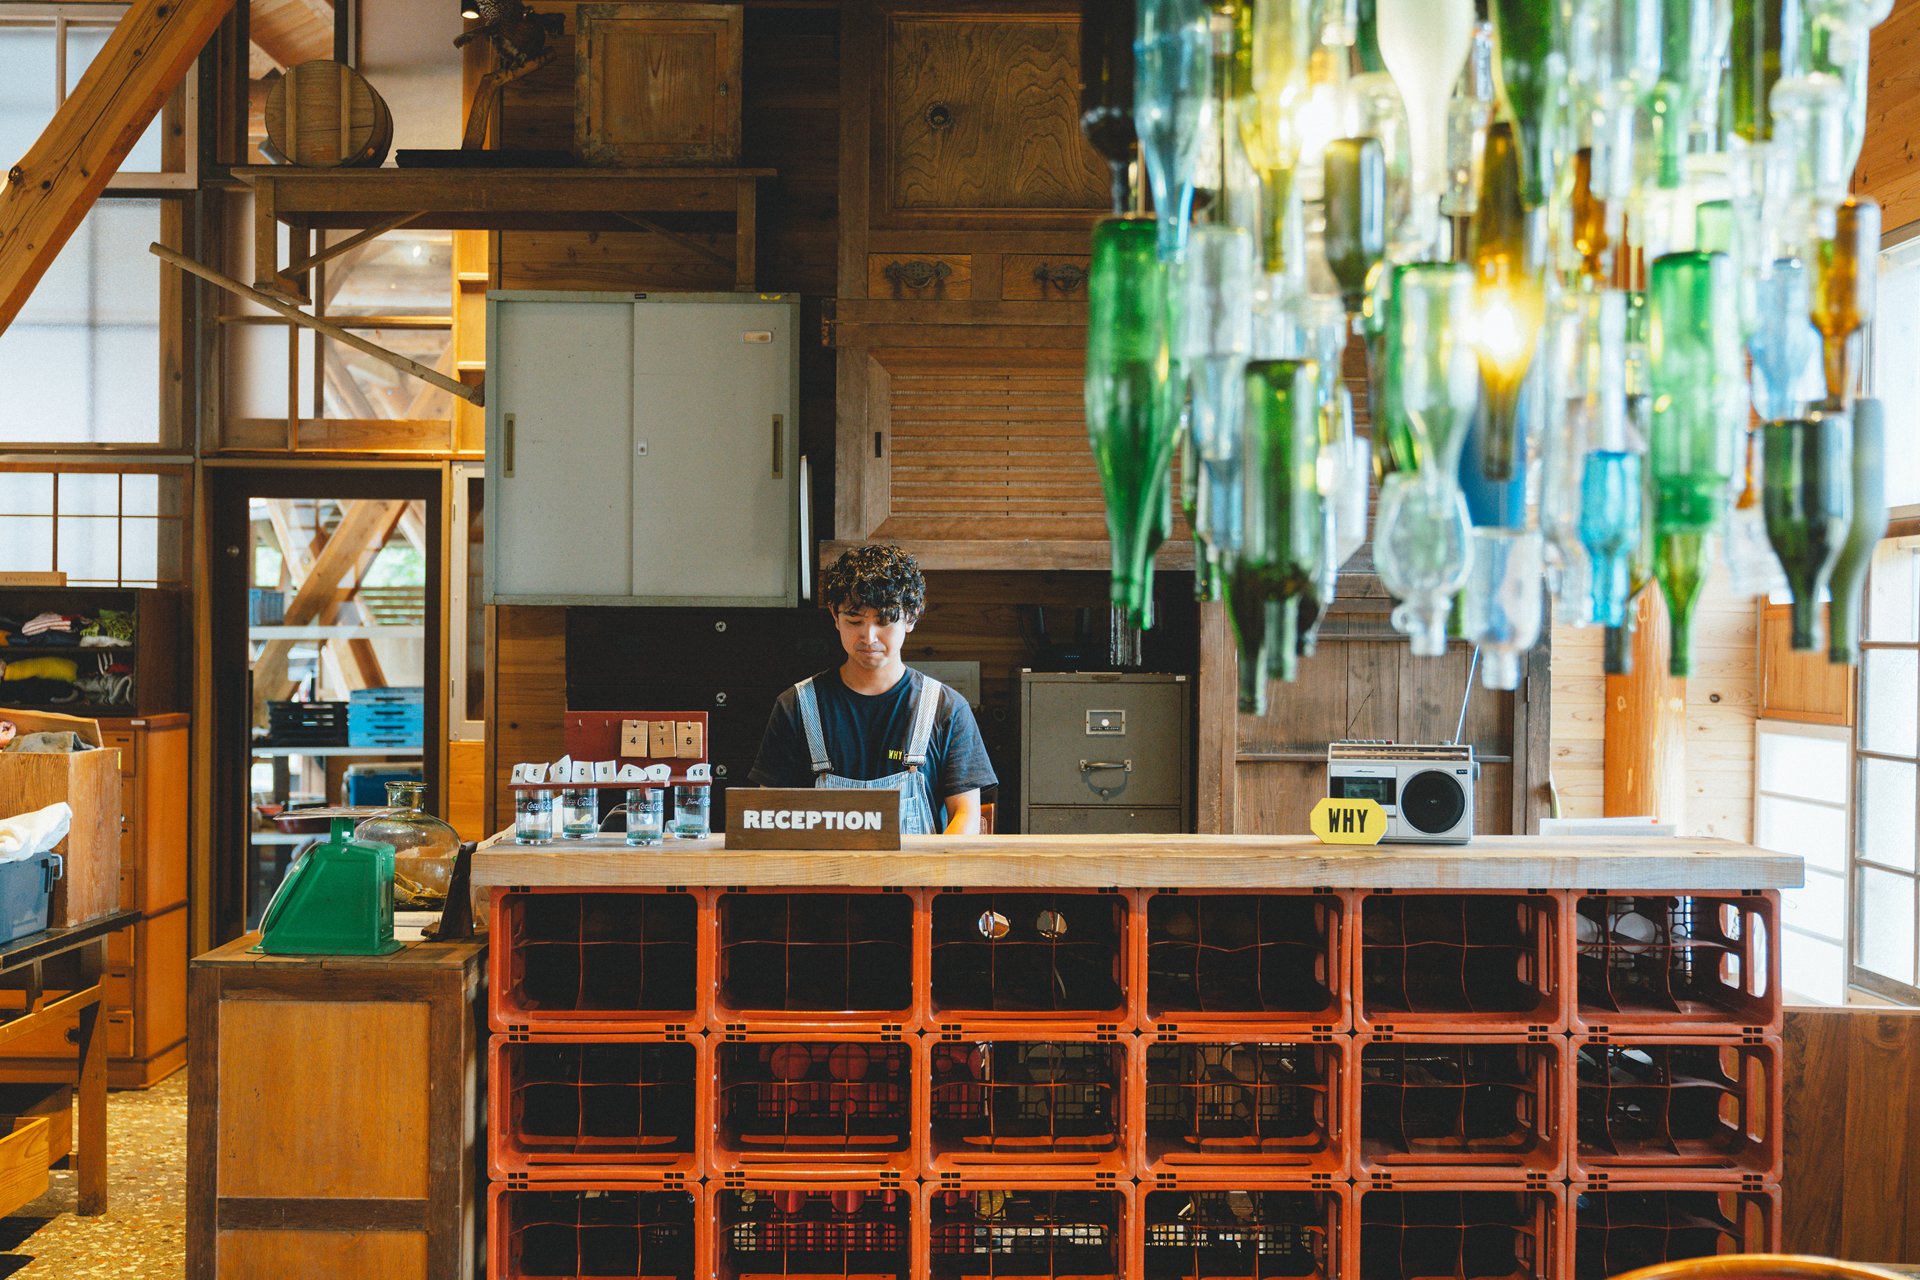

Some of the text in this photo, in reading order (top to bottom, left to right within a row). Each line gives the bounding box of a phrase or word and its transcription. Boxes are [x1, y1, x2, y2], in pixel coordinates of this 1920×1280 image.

[888, 749, 903, 760] WHY
[743, 809, 882, 831] RECEPTION
[1328, 808, 1369, 833] WHY
